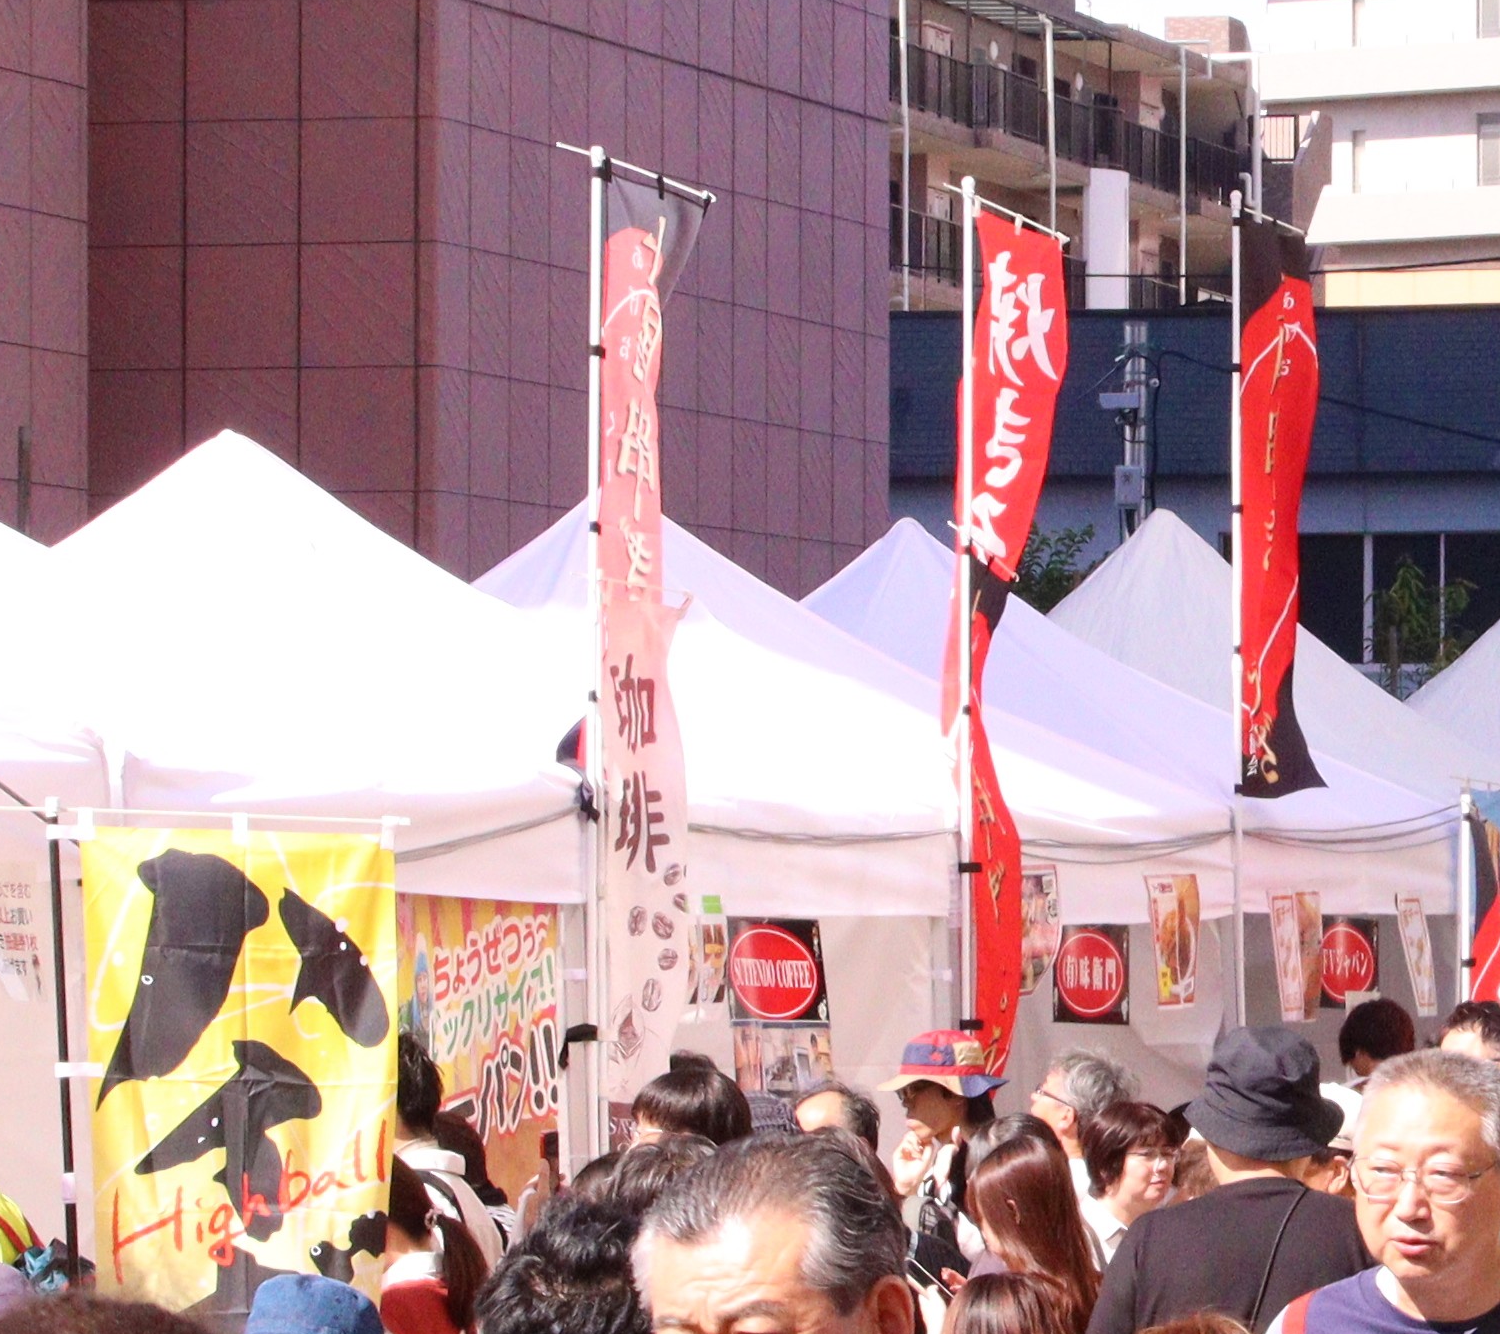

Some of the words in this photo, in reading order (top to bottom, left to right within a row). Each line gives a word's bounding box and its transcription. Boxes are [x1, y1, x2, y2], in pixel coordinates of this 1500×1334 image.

[610, 652, 672, 874] 珈琲
[776, 958, 813, 989] COFFEE
[112, 1118, 387, 1286] Highball
